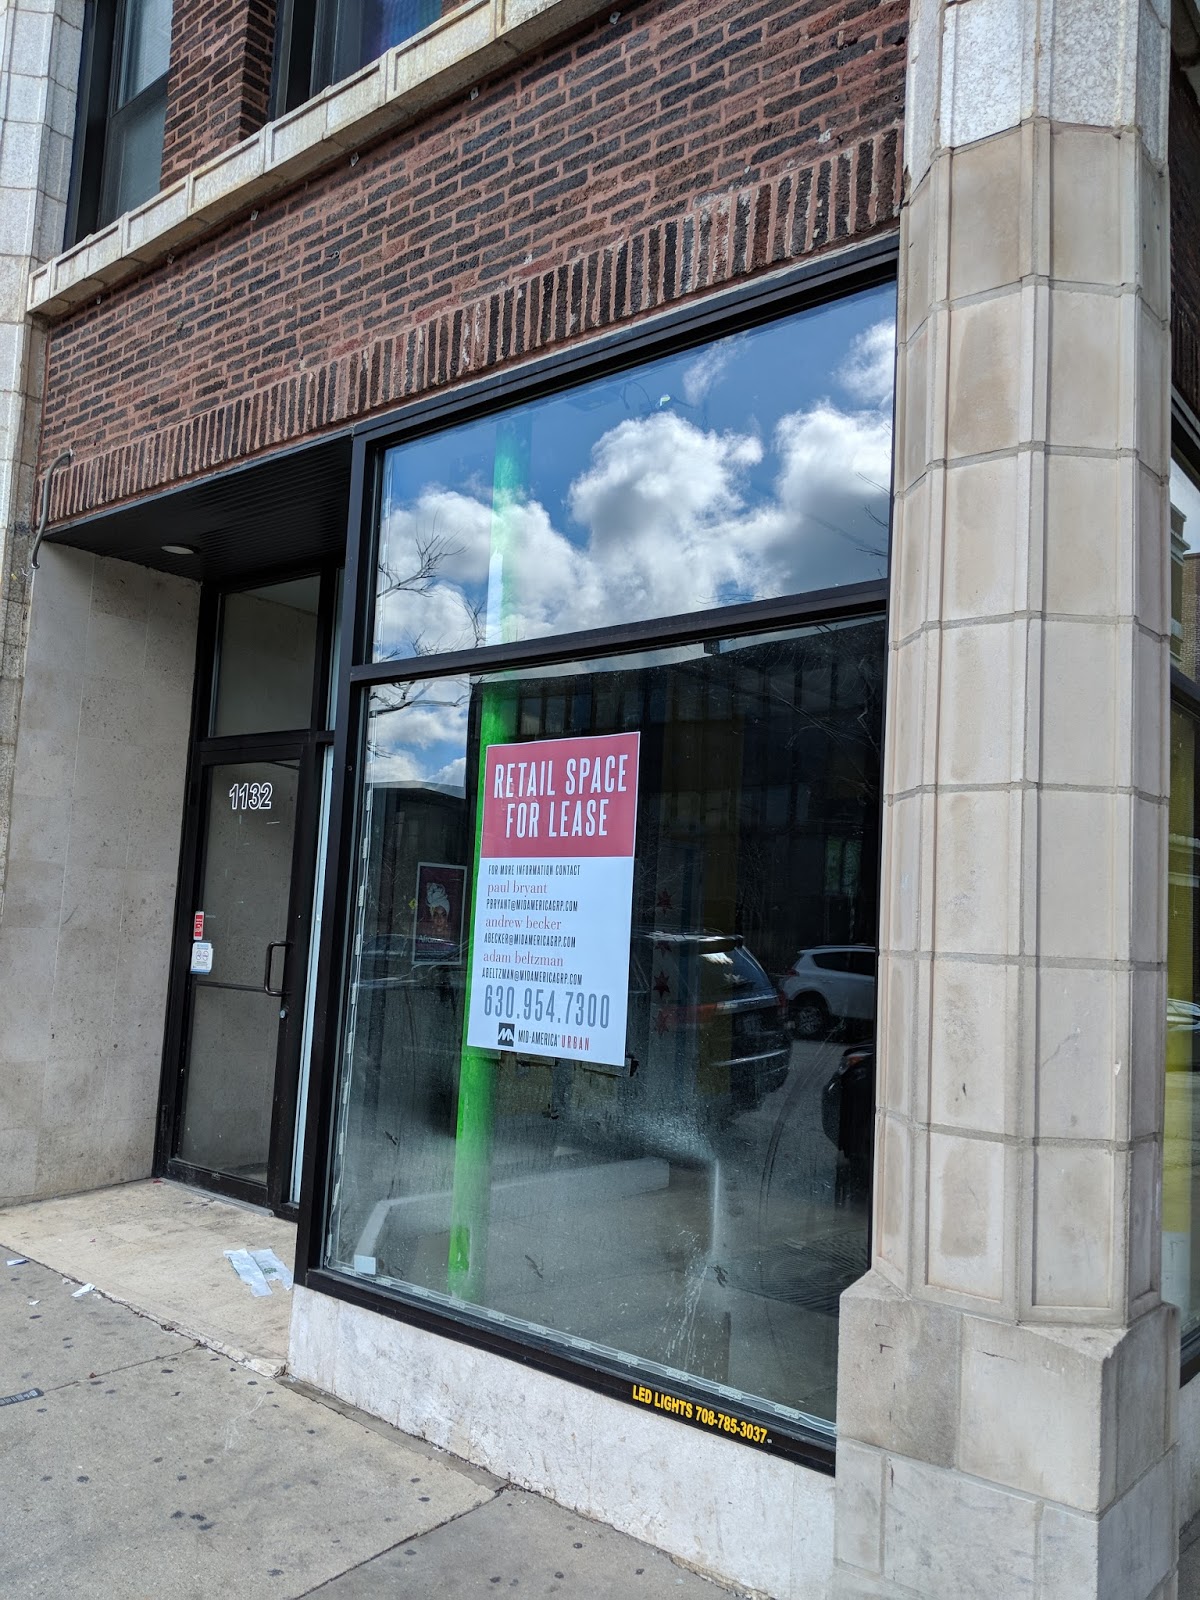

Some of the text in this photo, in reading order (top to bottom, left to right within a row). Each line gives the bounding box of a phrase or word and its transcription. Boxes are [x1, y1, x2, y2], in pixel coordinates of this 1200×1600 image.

[494, 754, 629, 799] RETAIL SPACE
[229, 782, 273, 810] 1132
[506, 798, 609, 838] FOR LEASE
[488, 864, 581, 876] FOR MORE INFORMATION CONTACT
[487, 880, 548, 897] paul bryant
[485, 915, 562, 930] andrew becker
[483, 949, 564, 967] adam beltzman
[484, 984, 610, 1029] 630.954.7300
[561, 1035, 590, 1051] URBAN
[632, 1384, 768, 1444] LED LIGHTS 708-785-3037
